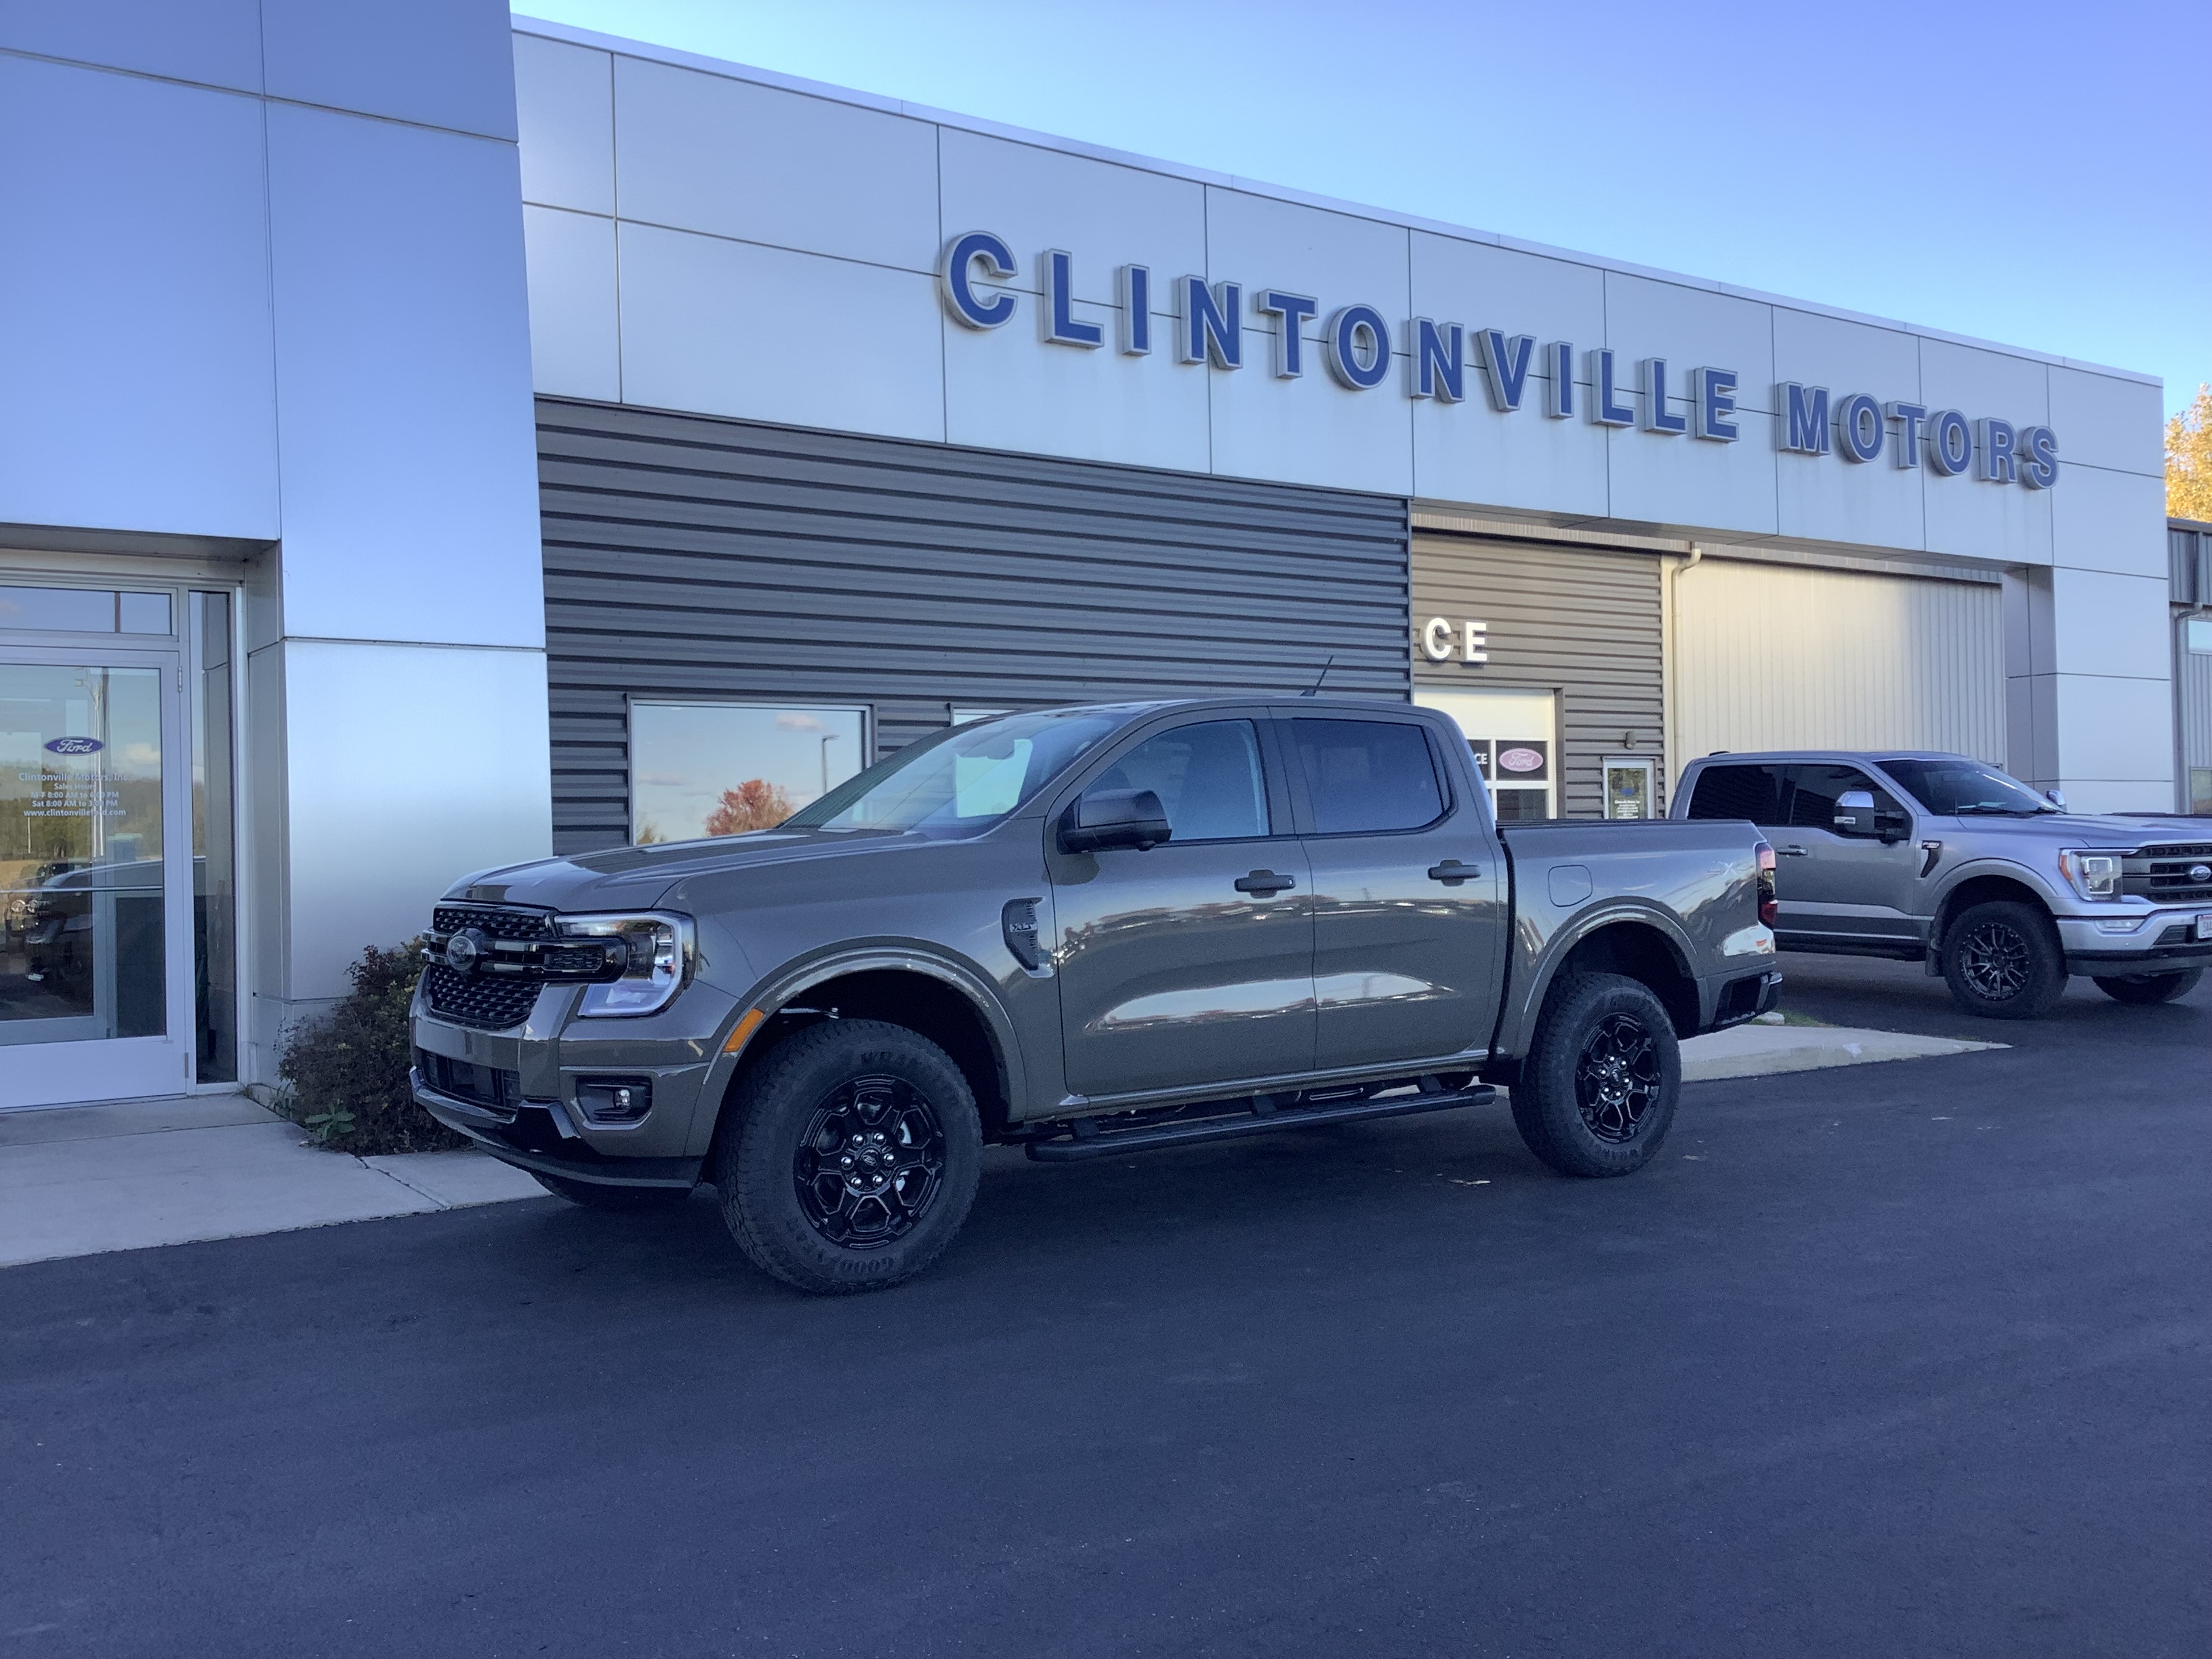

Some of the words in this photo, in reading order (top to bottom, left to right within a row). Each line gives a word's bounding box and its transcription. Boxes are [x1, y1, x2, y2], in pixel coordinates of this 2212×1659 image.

[941, 230, 1740, 444] CLINTONVILLE
[1778, 380, 2060, 490] MOTORS
[56, 739, 93, 753] Ford
[1509, 752, 1534, 766] Ford
[18, 773, 72, 781] Clintonville
